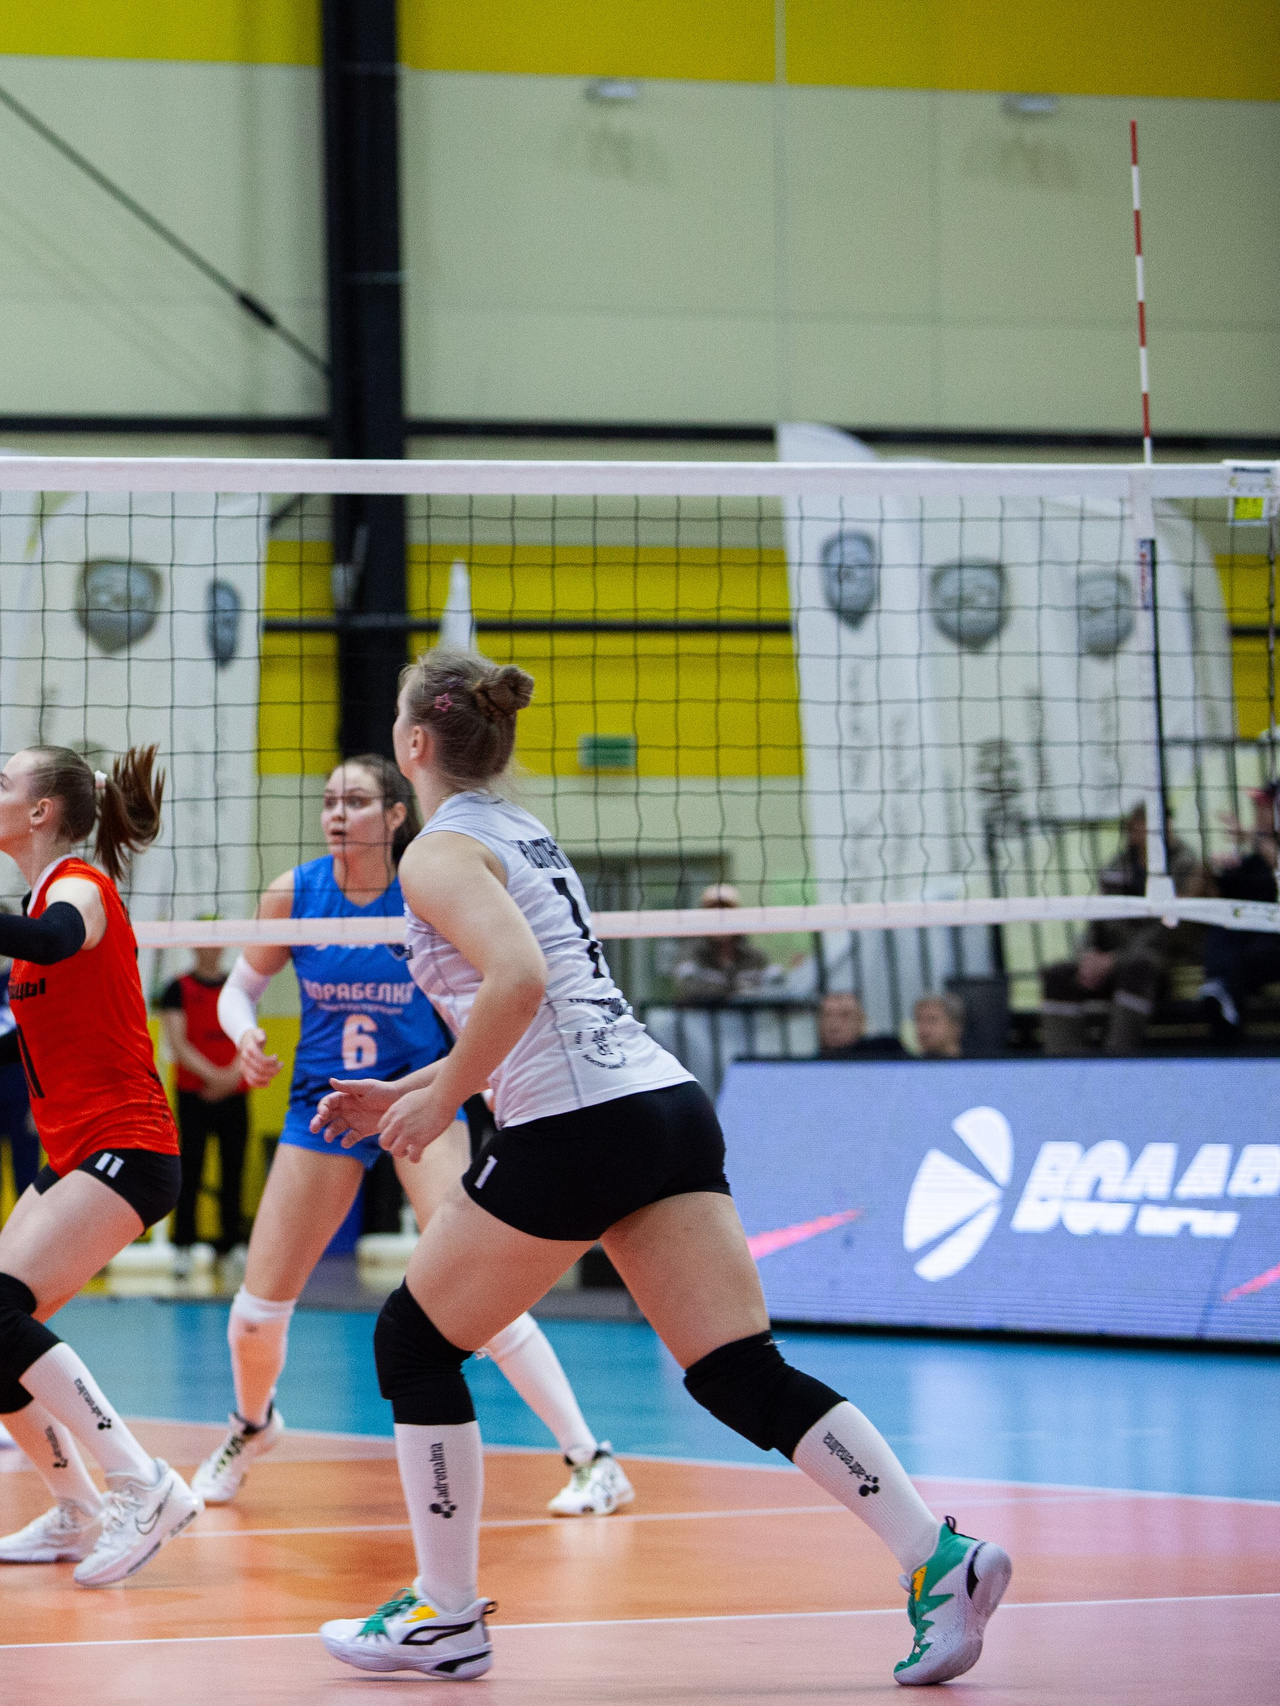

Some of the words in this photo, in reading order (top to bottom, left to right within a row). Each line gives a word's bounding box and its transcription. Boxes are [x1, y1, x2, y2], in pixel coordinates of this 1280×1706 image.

[341, 1014, 378, 1071] 6
[94, 1152, 125, 1179] 11
[473, 1154, 498, 1190] 1
[429, 1441, 450, 1498] adrenalina
[822, 1430, 867, 1479] adrenalina
